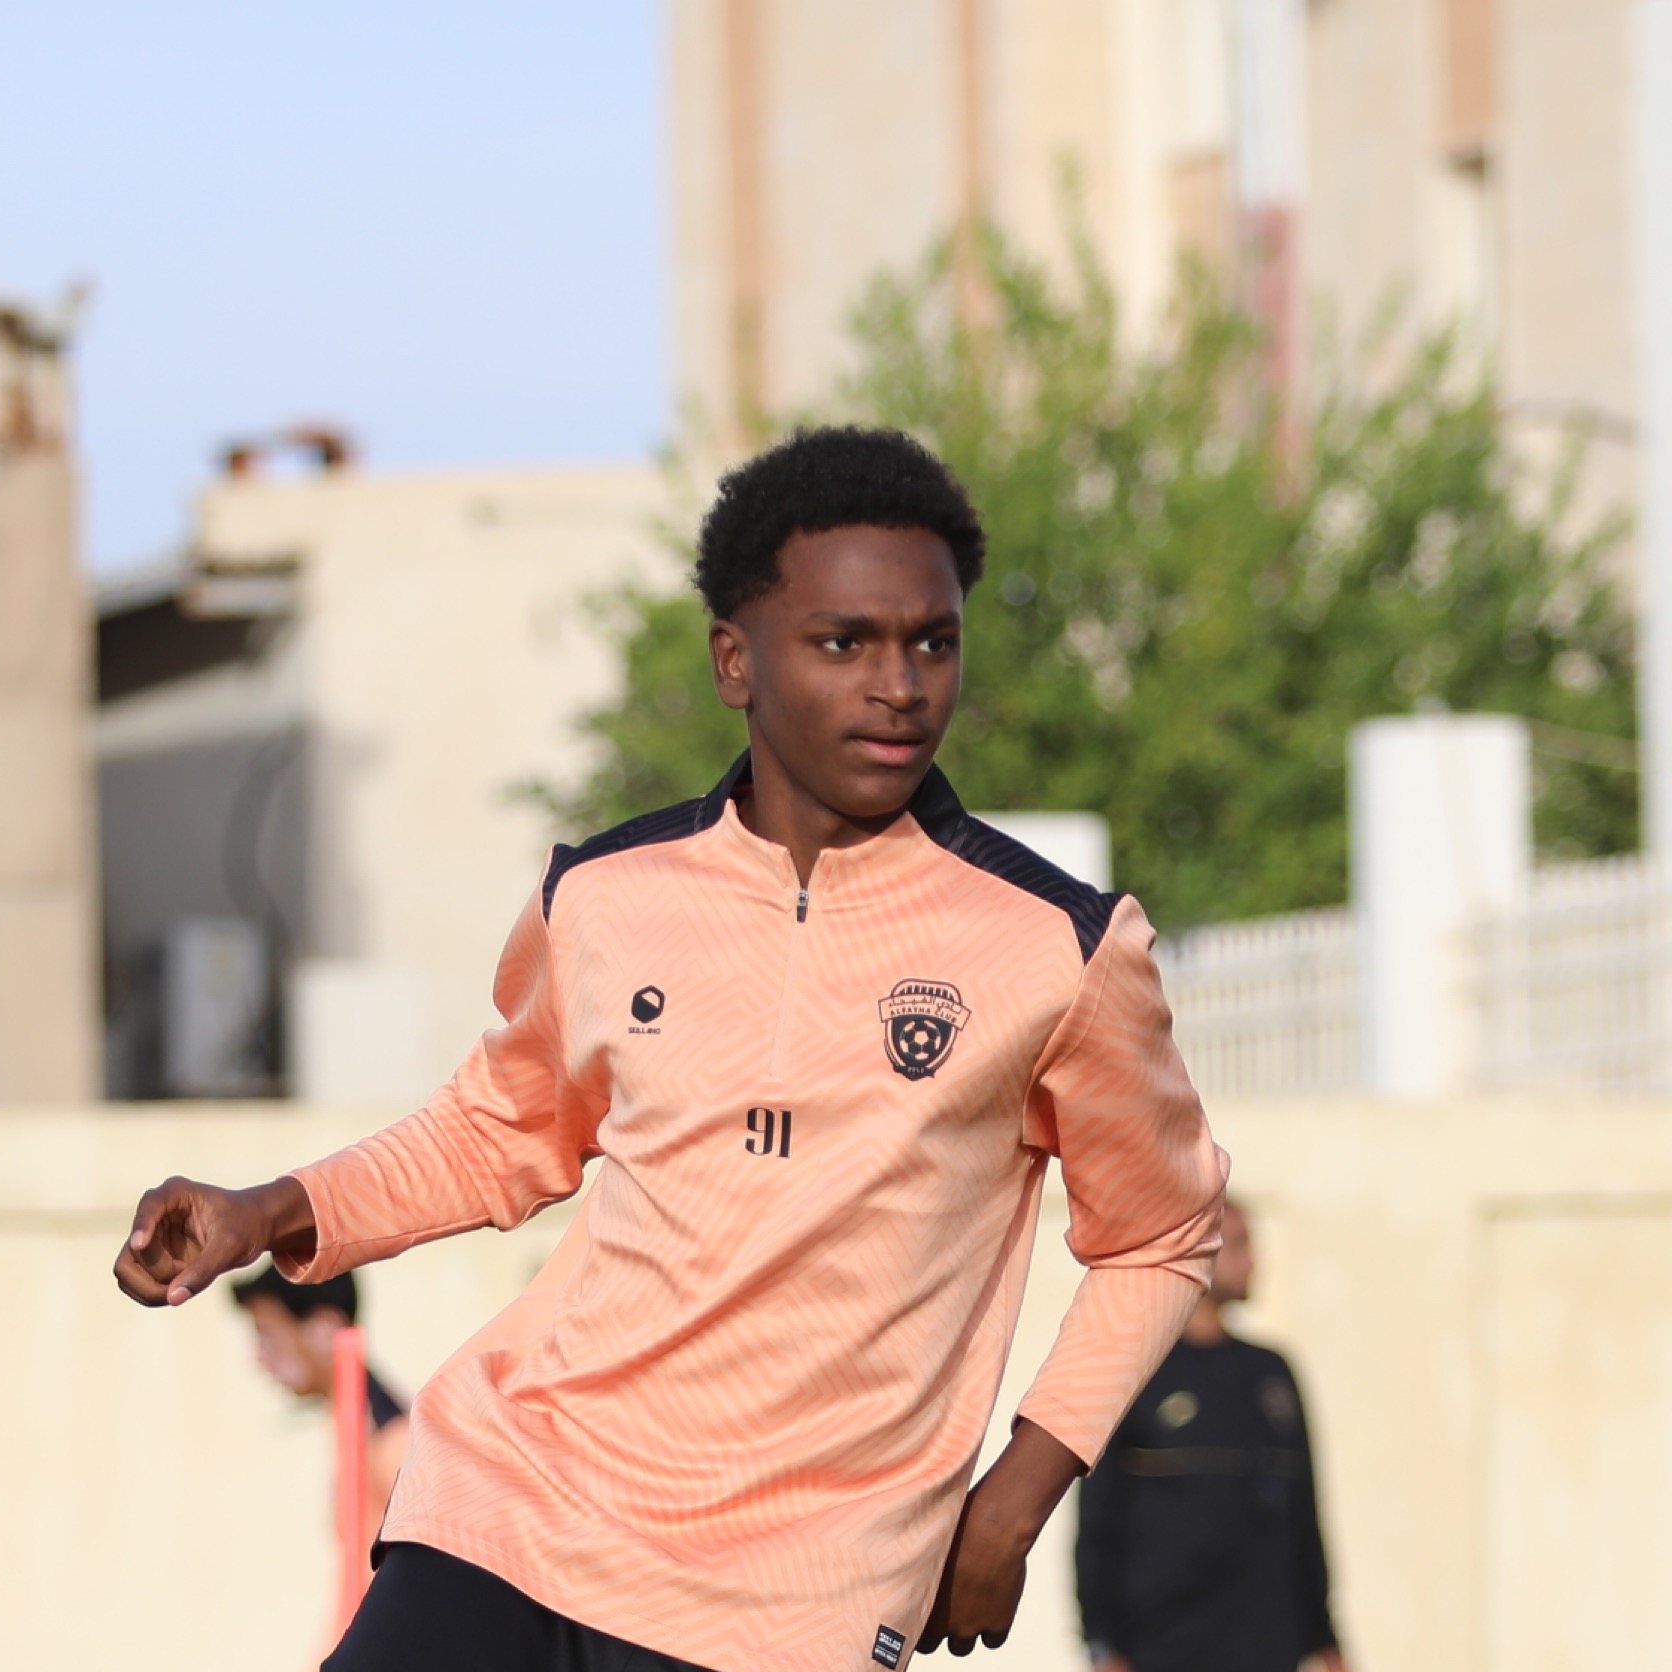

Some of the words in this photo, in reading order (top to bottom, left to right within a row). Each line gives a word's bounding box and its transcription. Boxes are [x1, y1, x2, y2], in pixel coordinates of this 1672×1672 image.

[890, 1006, 931, 1016] ALFAYHA
[934, 1010, 958, 1023] CLUB
[744, 1107, 792, 1159] 91
